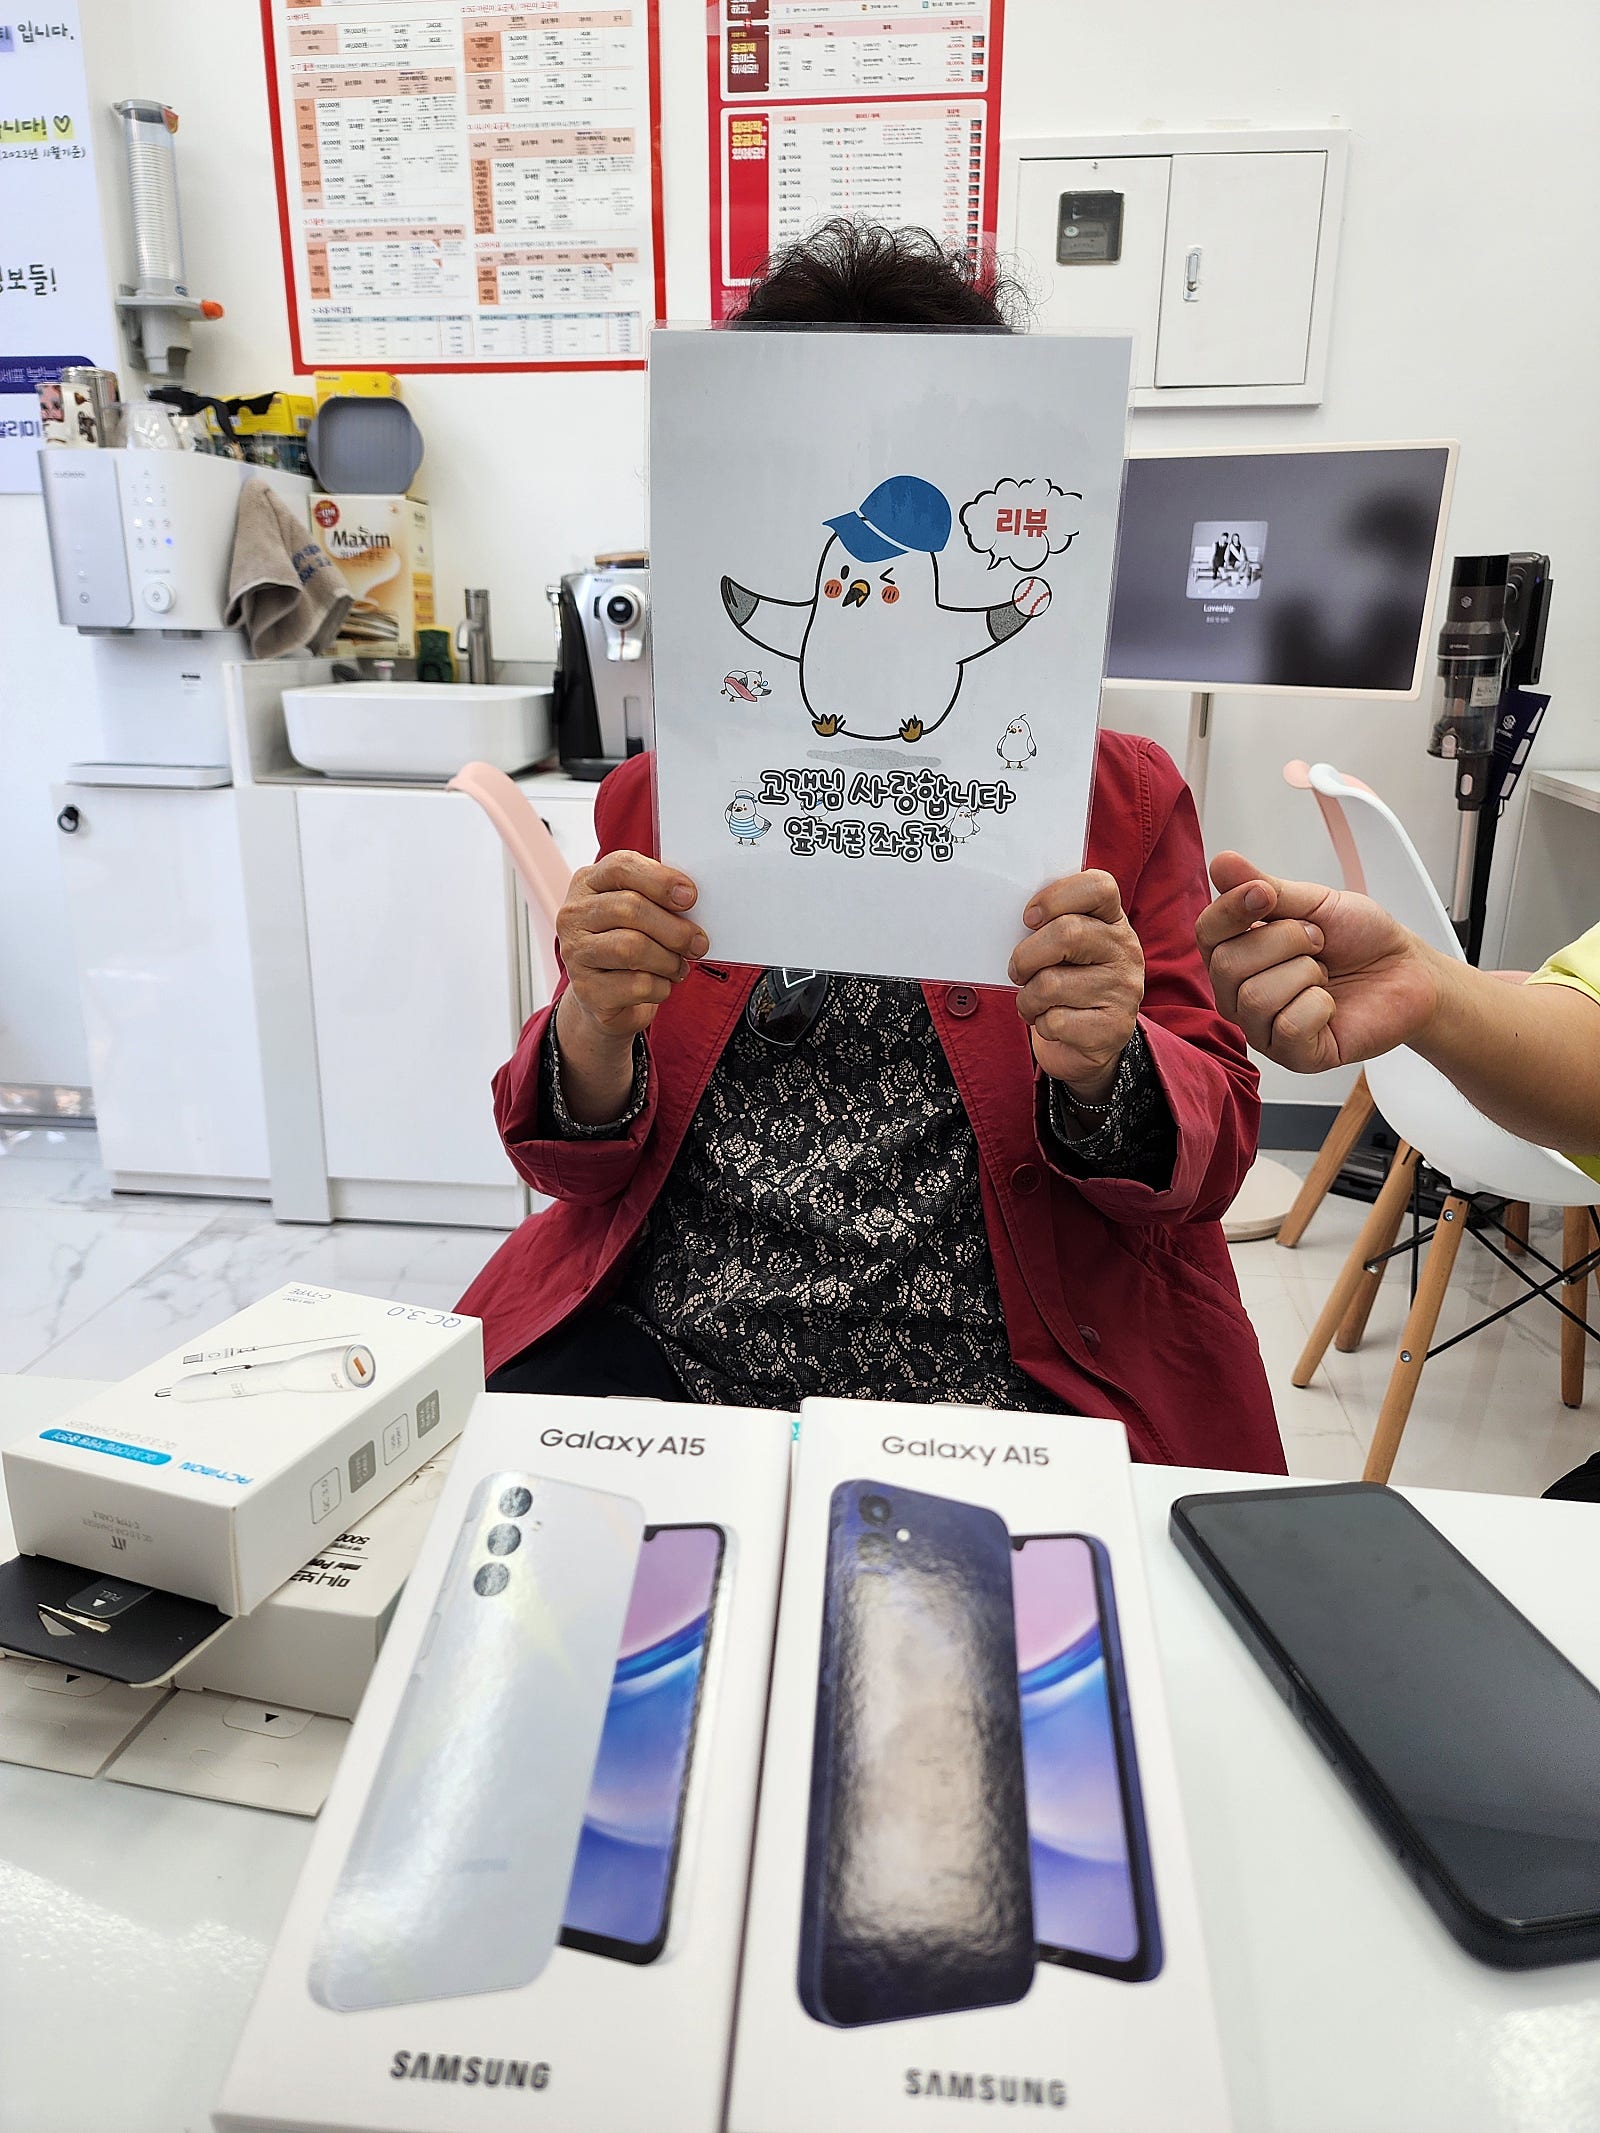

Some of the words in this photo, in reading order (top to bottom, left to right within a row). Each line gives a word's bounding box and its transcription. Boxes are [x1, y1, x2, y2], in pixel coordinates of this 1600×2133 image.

[17, 20, 75, 43] 입니다.
[995, 508, 1048, 538] 리뷰
[332, 528, 391, 549] Maxim
[758, 768, 845, 810] 고객님
[848, 768, 1017, 820] 사랑합니다
[784, 817, 865, 858] 옆커폰
[868, 820, 955, 862] 좌동점
[289, 1288, 332, 1300] C-TYPE
[387, 1306, 426, 1320] 3.0
[425, 1314, 462, 1328] QC
[540, 1428, 654, 1458] Galaxy
[658, 1436, 706, 1457] A15
[881, 1435, 997, 1467] Galaxy
[1002, 1444, 1050, 1467] A15
[390, 2050, 552, 2091] SAMSUNG
[904, 2067, 1068, 2109] SAMSUNG
